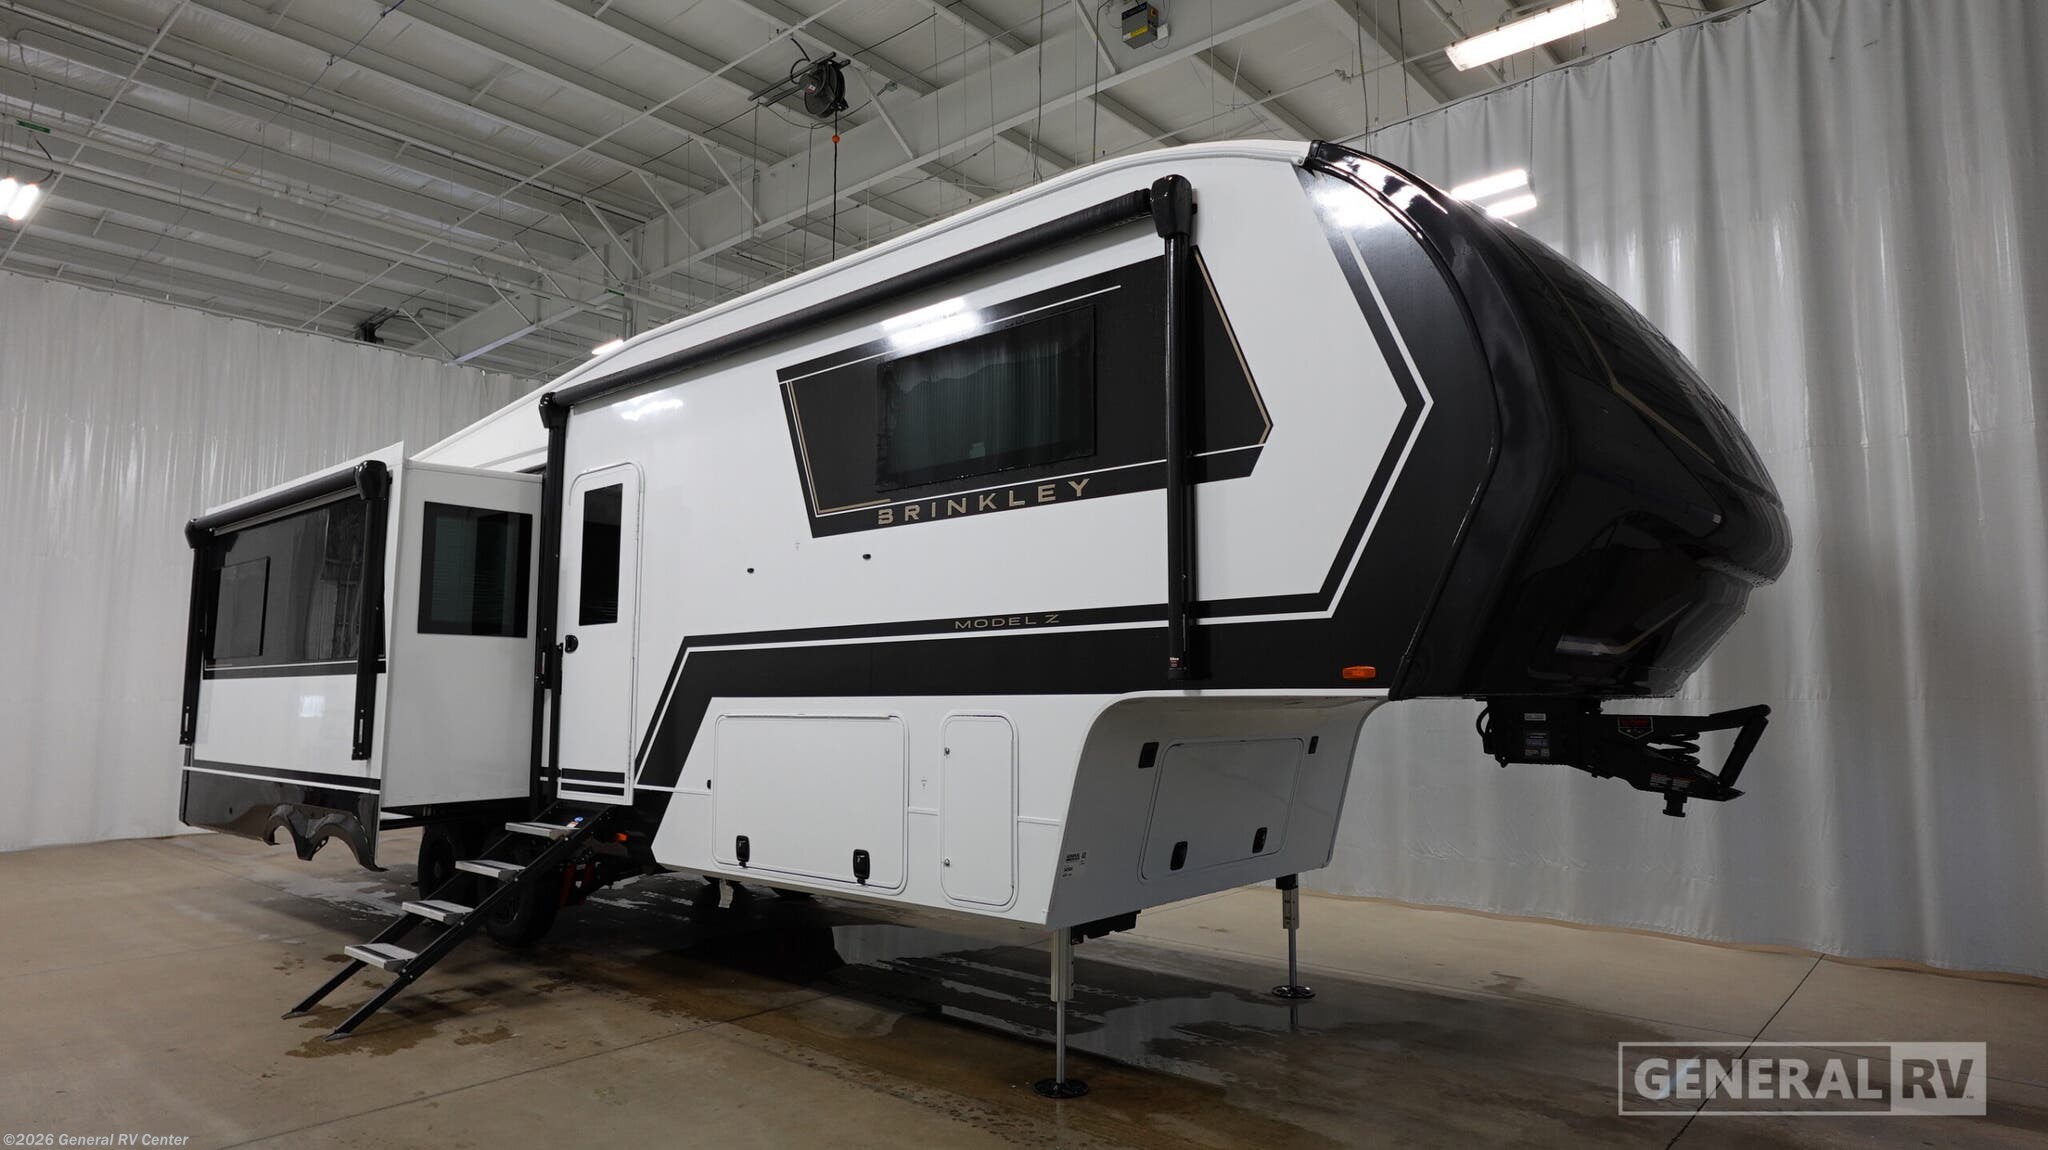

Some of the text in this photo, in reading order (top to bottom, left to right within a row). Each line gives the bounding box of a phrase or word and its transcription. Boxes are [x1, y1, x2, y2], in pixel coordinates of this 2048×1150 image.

[878, 478, 1090, 525] BRINKLEY
[955, 614, 1060, 630] MODEL Z
